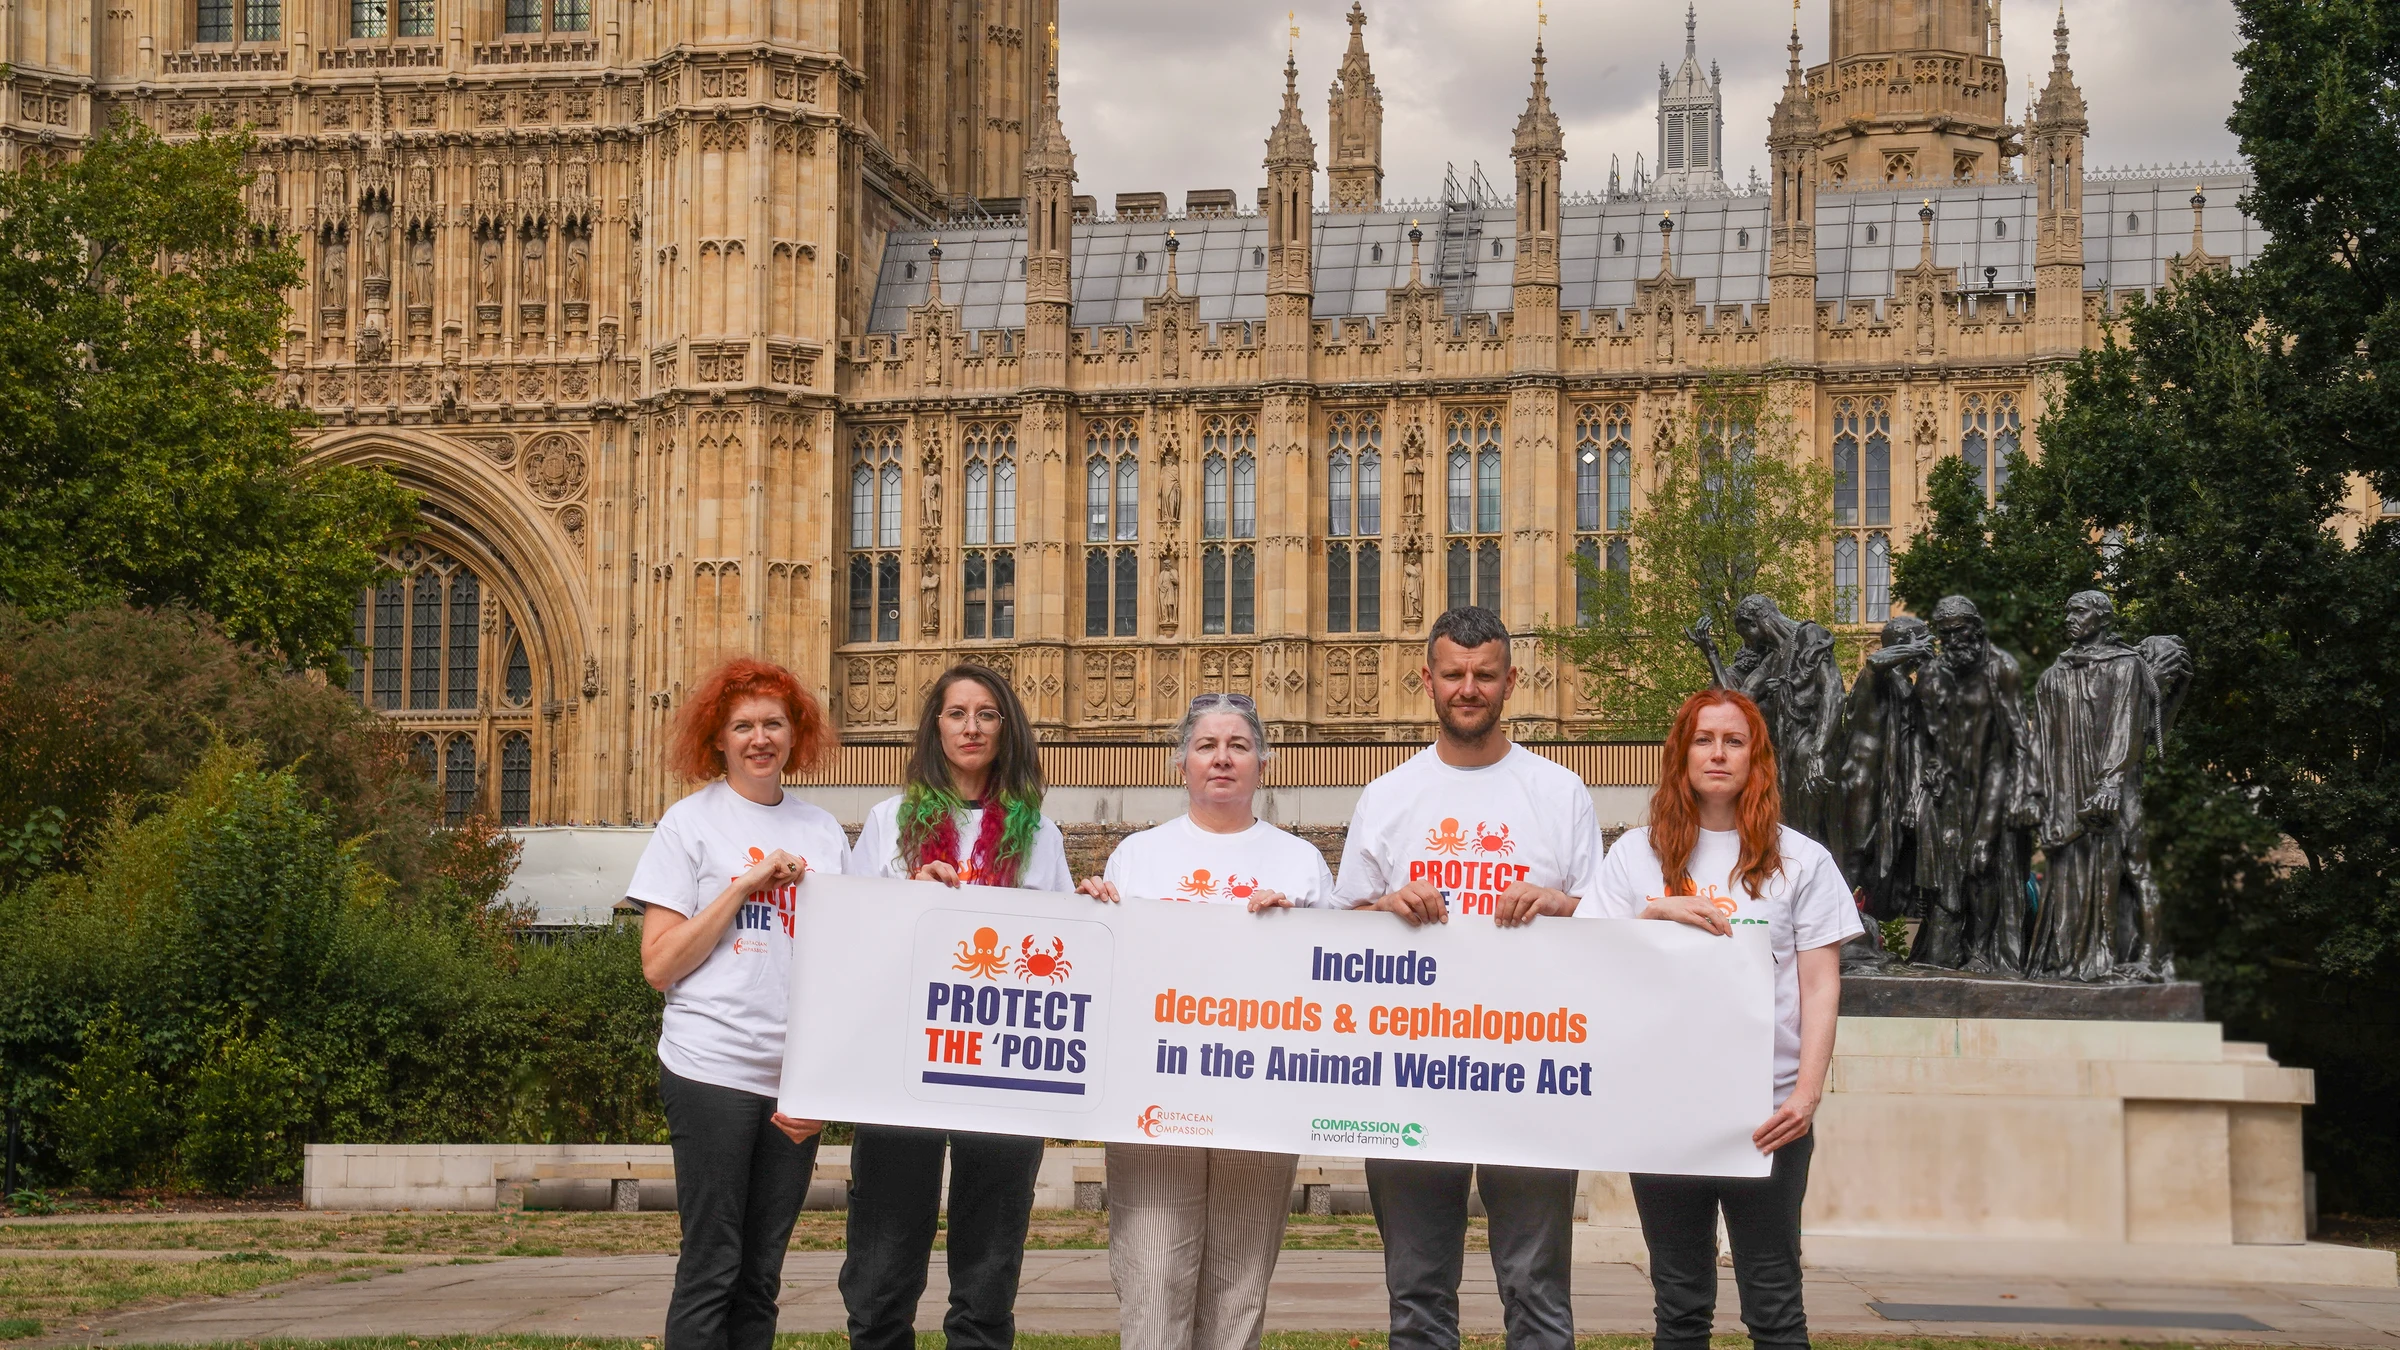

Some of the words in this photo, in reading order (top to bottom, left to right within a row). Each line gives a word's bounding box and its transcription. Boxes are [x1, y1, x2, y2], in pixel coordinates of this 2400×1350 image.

[1410, 860, 1530, 893] PROTECT
[735, 904, 772, 931] THE
[1312, 946, 1437, 986] Include
[927, 982, 1092, 1032] PROTECT
[1154, 988, 1322, 1032] decapods
[1333, 1003, 1357, 1034] &
[1368, 1002, 1588, 1045] cephalopods
[925, 1028, 983, 1065] THE
[1156, 1039, 1188, 1075] in
[1200, 1042, 1255, 1080] the
[1265, 1046, 1383, 1087] Animal
[1394, 1052, 1526, 1094] Welfare
[1536, 1058, 1593, 1097] Act
[1311, 1118, 1400, 1133] COMPASSION
[1311, 1130, 1321, 1141] in
[1323, 1132, 1355, 1143] world
[1357, 1133, 1399, 1149] farming
